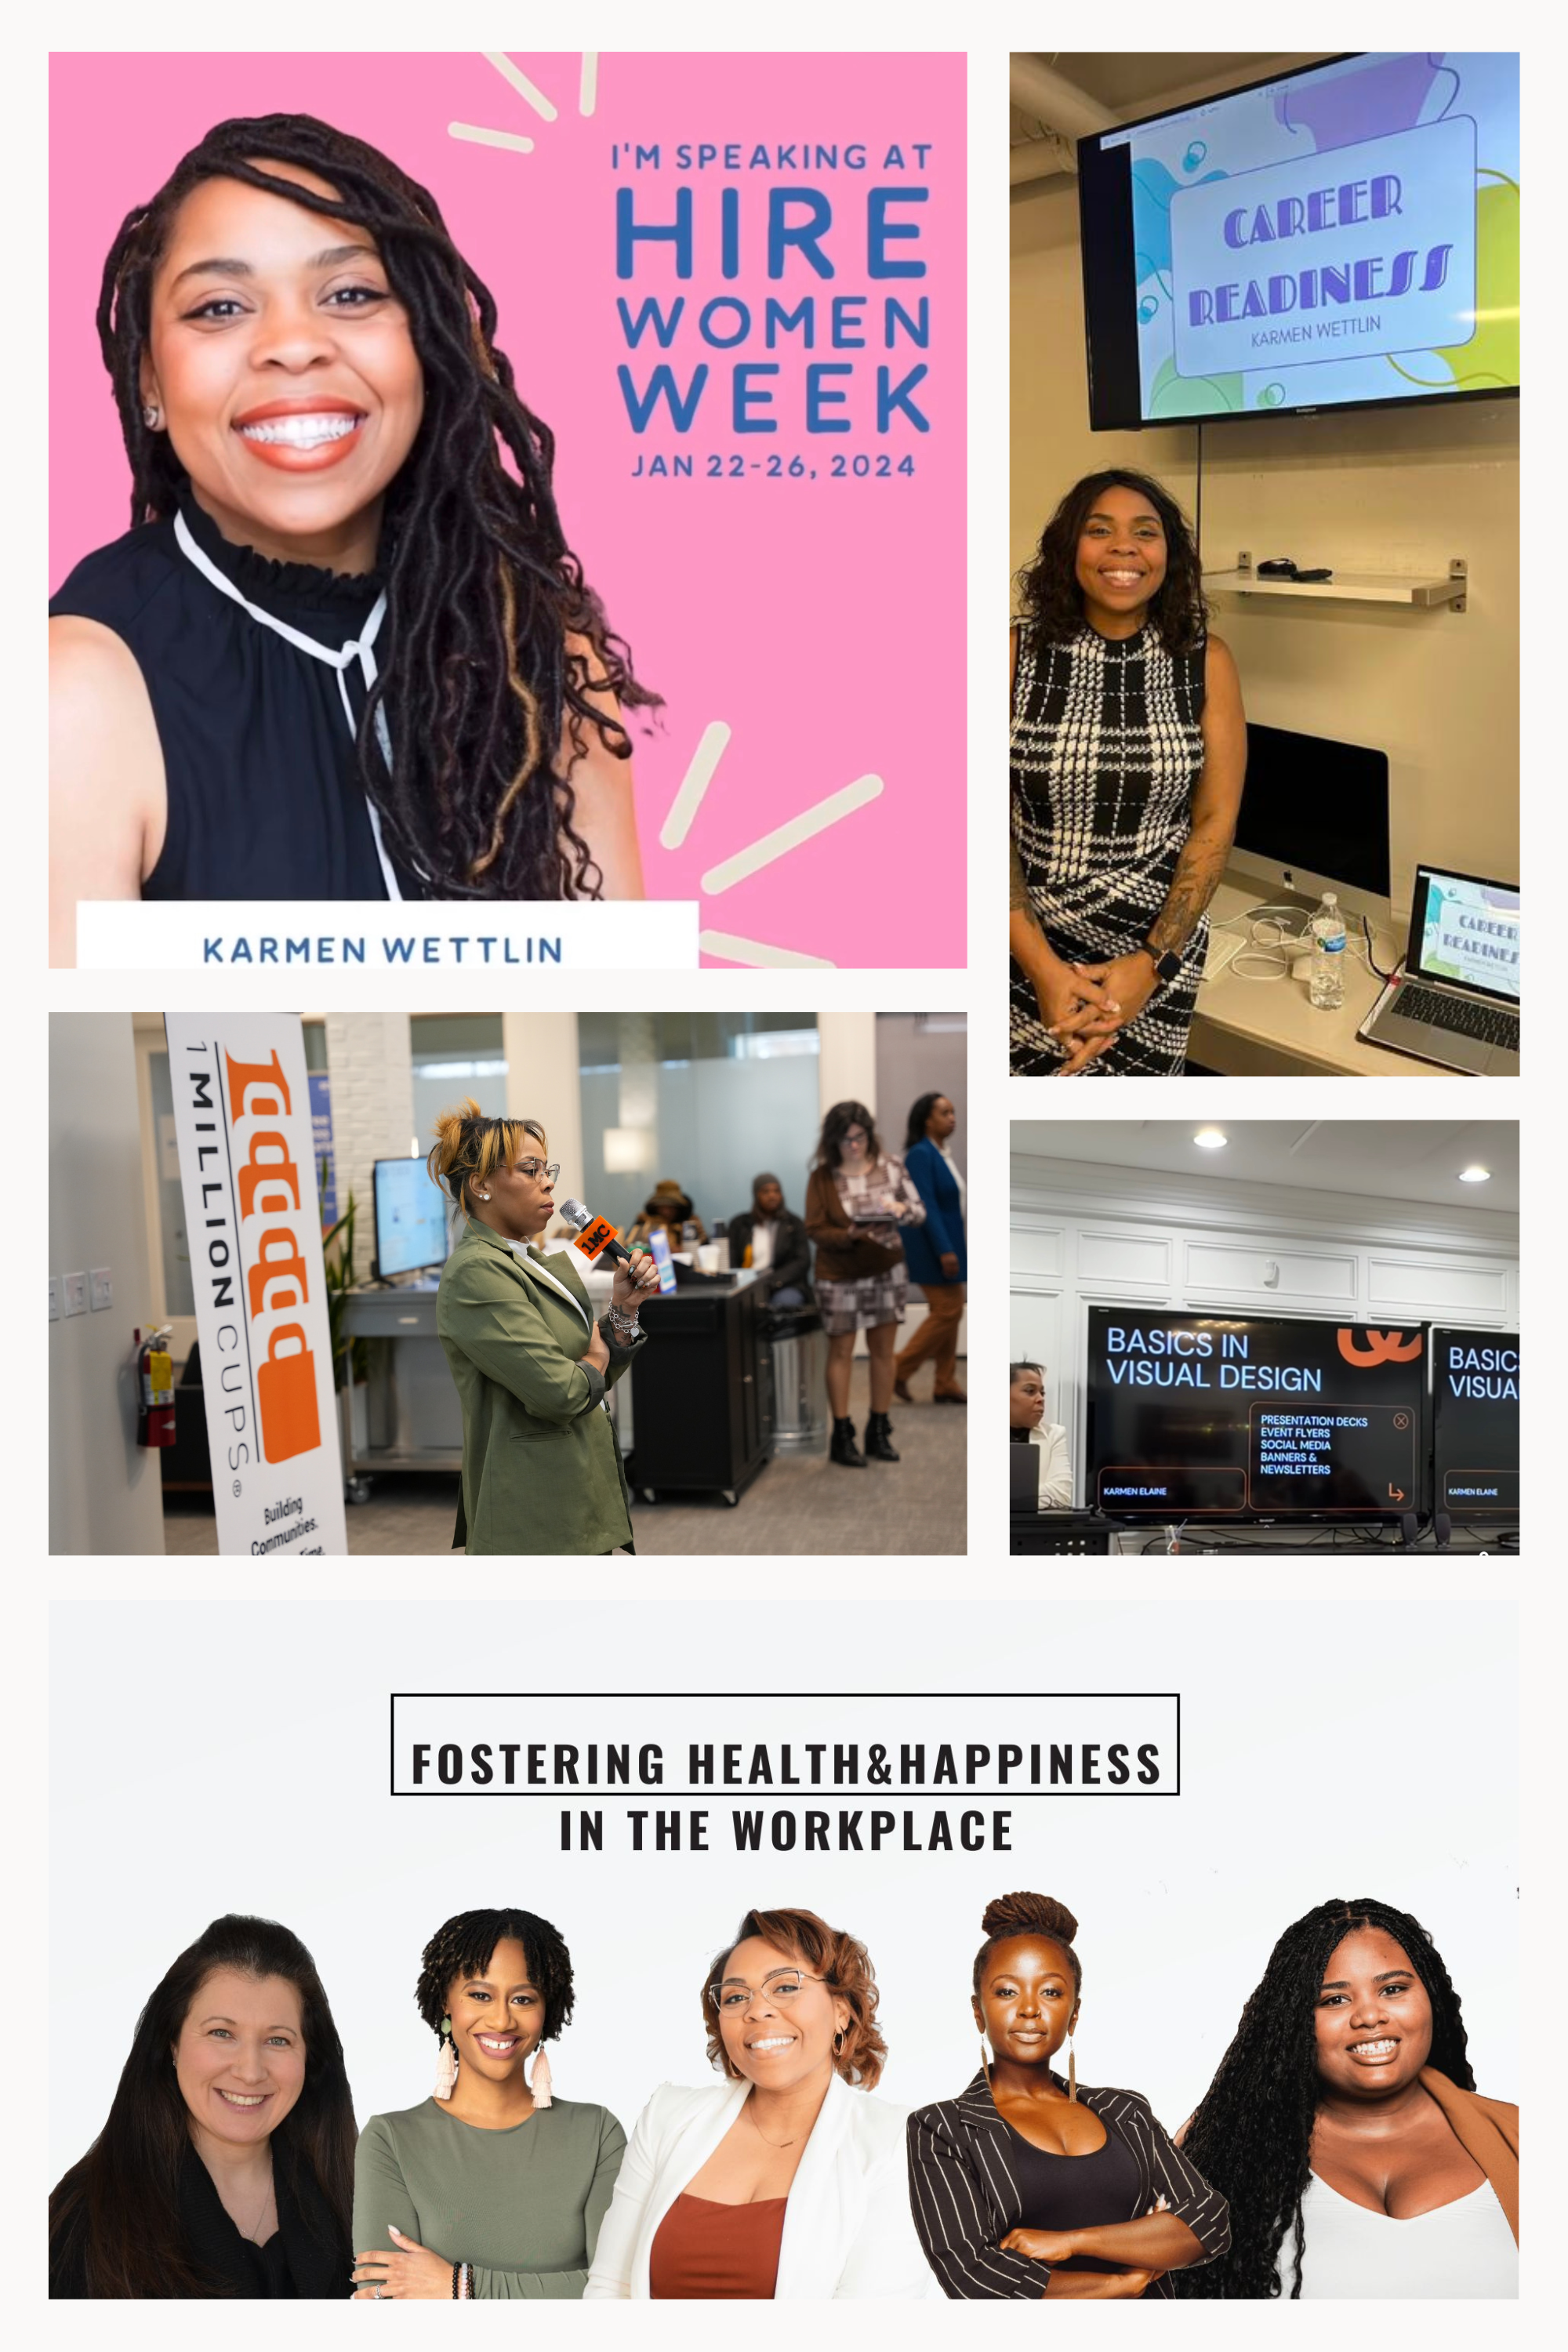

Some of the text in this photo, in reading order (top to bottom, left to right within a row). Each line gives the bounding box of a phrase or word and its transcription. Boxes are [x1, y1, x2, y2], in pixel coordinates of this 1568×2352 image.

[612, 143, 932, 169] I'M SPEAKING AT
[1224, 175, 1403, 249] CAREER
[616, 186, 929, 280] HIRE
[1189, 244, 1454, 327] READINESS
[616, 296, 929, 349] WOMEN
[1251, 315, 1381, 347] KARMEN WETTLIN
[617, 362, 931, 434] WEEK
[632, 455, 915, 480] JAN 22-26, 2024
[1459, 914, 1519, 940] CAREER
[203, 937, 562, 964] KARMEN WETTLIN
[187, 1040, 207, 1052] 1
[190, 1073, 234, 1308] MILLION
[581, 1224, 610, 1254] 1MC
[1107, 1327, 1248, 1359] BASICS IN
[1450, 1346, 1519, 1372] BASIC
[1106, 1359, 1322, 1392] VISUAL DESIGN
[1449, 1374, 1519, 1399] VISUA
[1261, 1414, 1368, 1427] PRESENTATION DECKS
[1261, 1427, 1330, 1439] EVENT FLYERS
[1261, 1439, 1331, 1450] SOCIAL MEDIA
[1261, 1452, 1317, 1462] BANNERS &
[1261, 1465, 1331, 1475] NEWSLETTERS
[1103, 1486, 1167, 1496] KARMEN ELAINE
[1448, 1487, 1475, 1496] KARMEN
[264, 1497, 303, 1526] Building
[251, 1517, 319, 1555] Communities.
[413, 1743, 1160, 1785] FOSTERING HEALTH&HAPPINESS
[561, 1810, 1012, 1851] IN THE WORKPLACE
